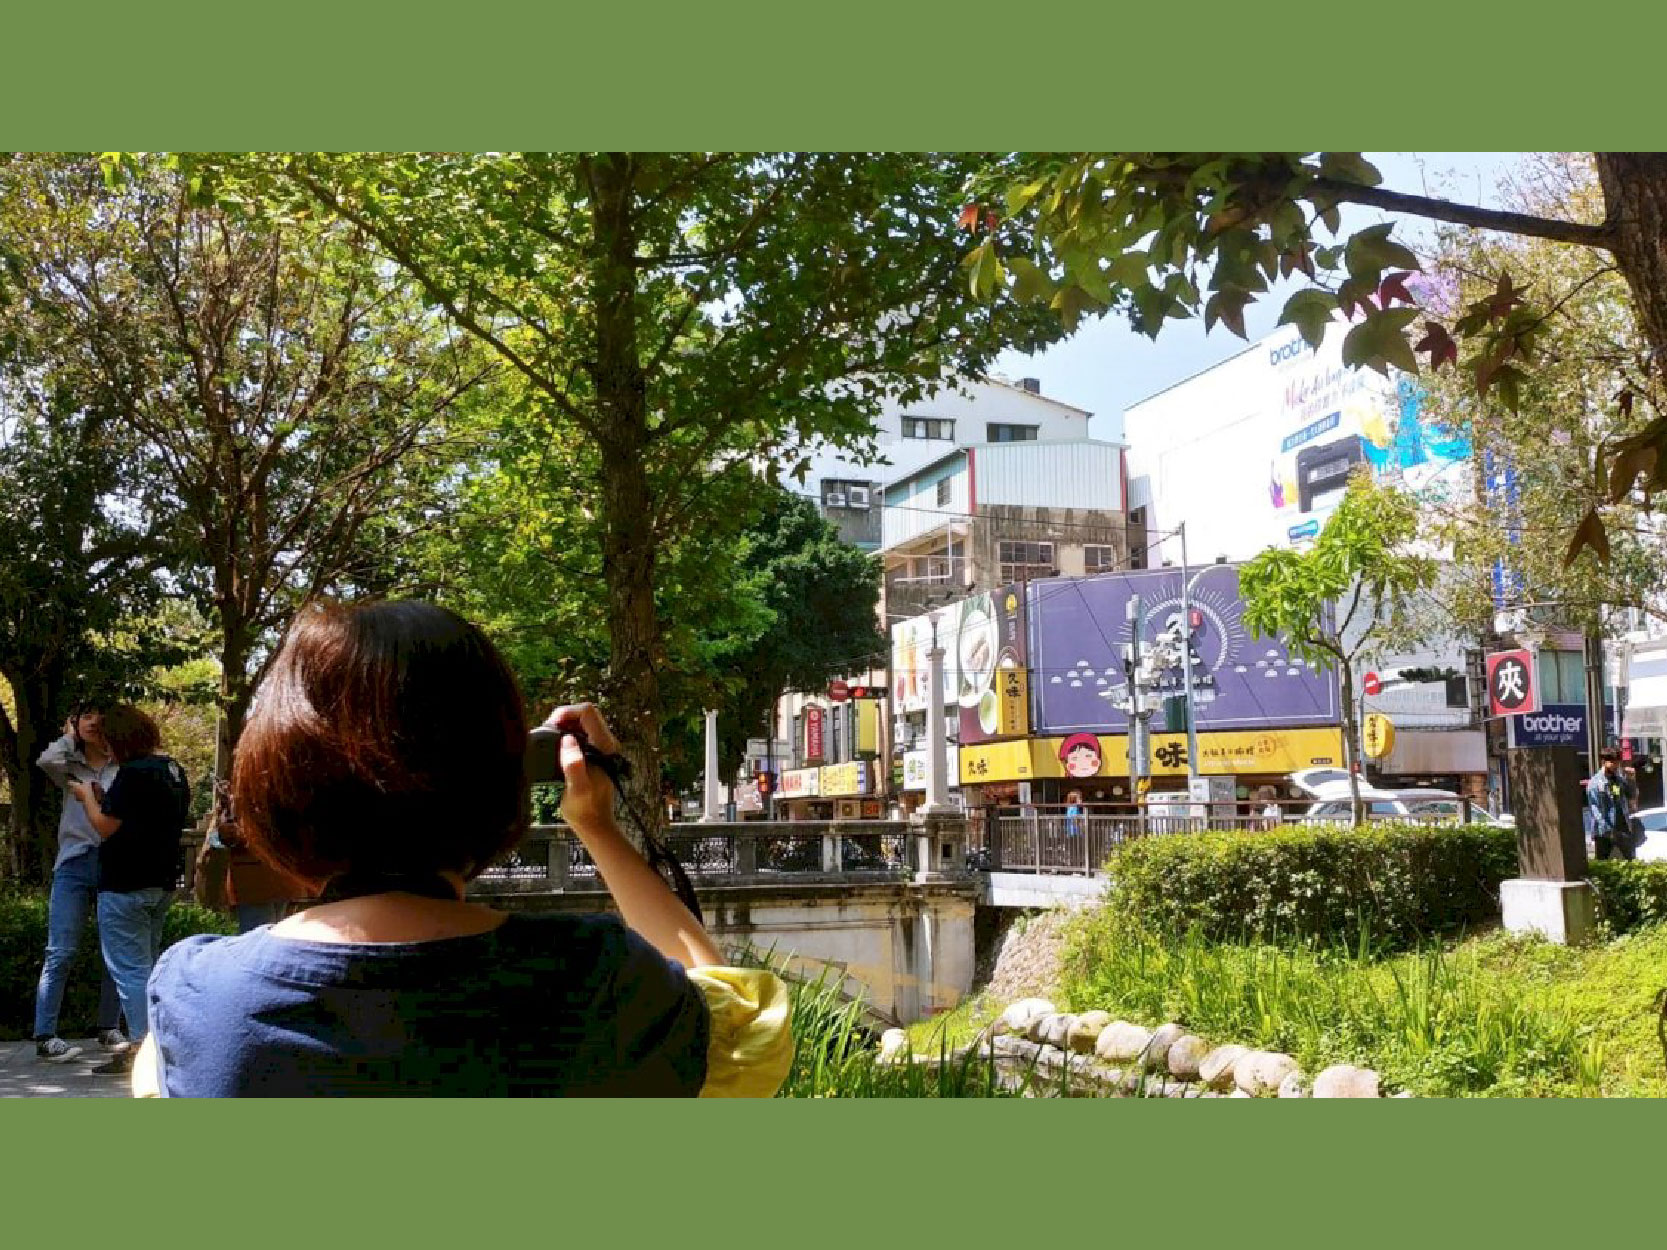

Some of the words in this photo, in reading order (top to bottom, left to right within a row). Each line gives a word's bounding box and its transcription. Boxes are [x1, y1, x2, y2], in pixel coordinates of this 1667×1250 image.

[1499, 661, 1525, 701] 夾
[1522, 713, 1583, 733] brother
[1543, 734, 1559, 743] your
